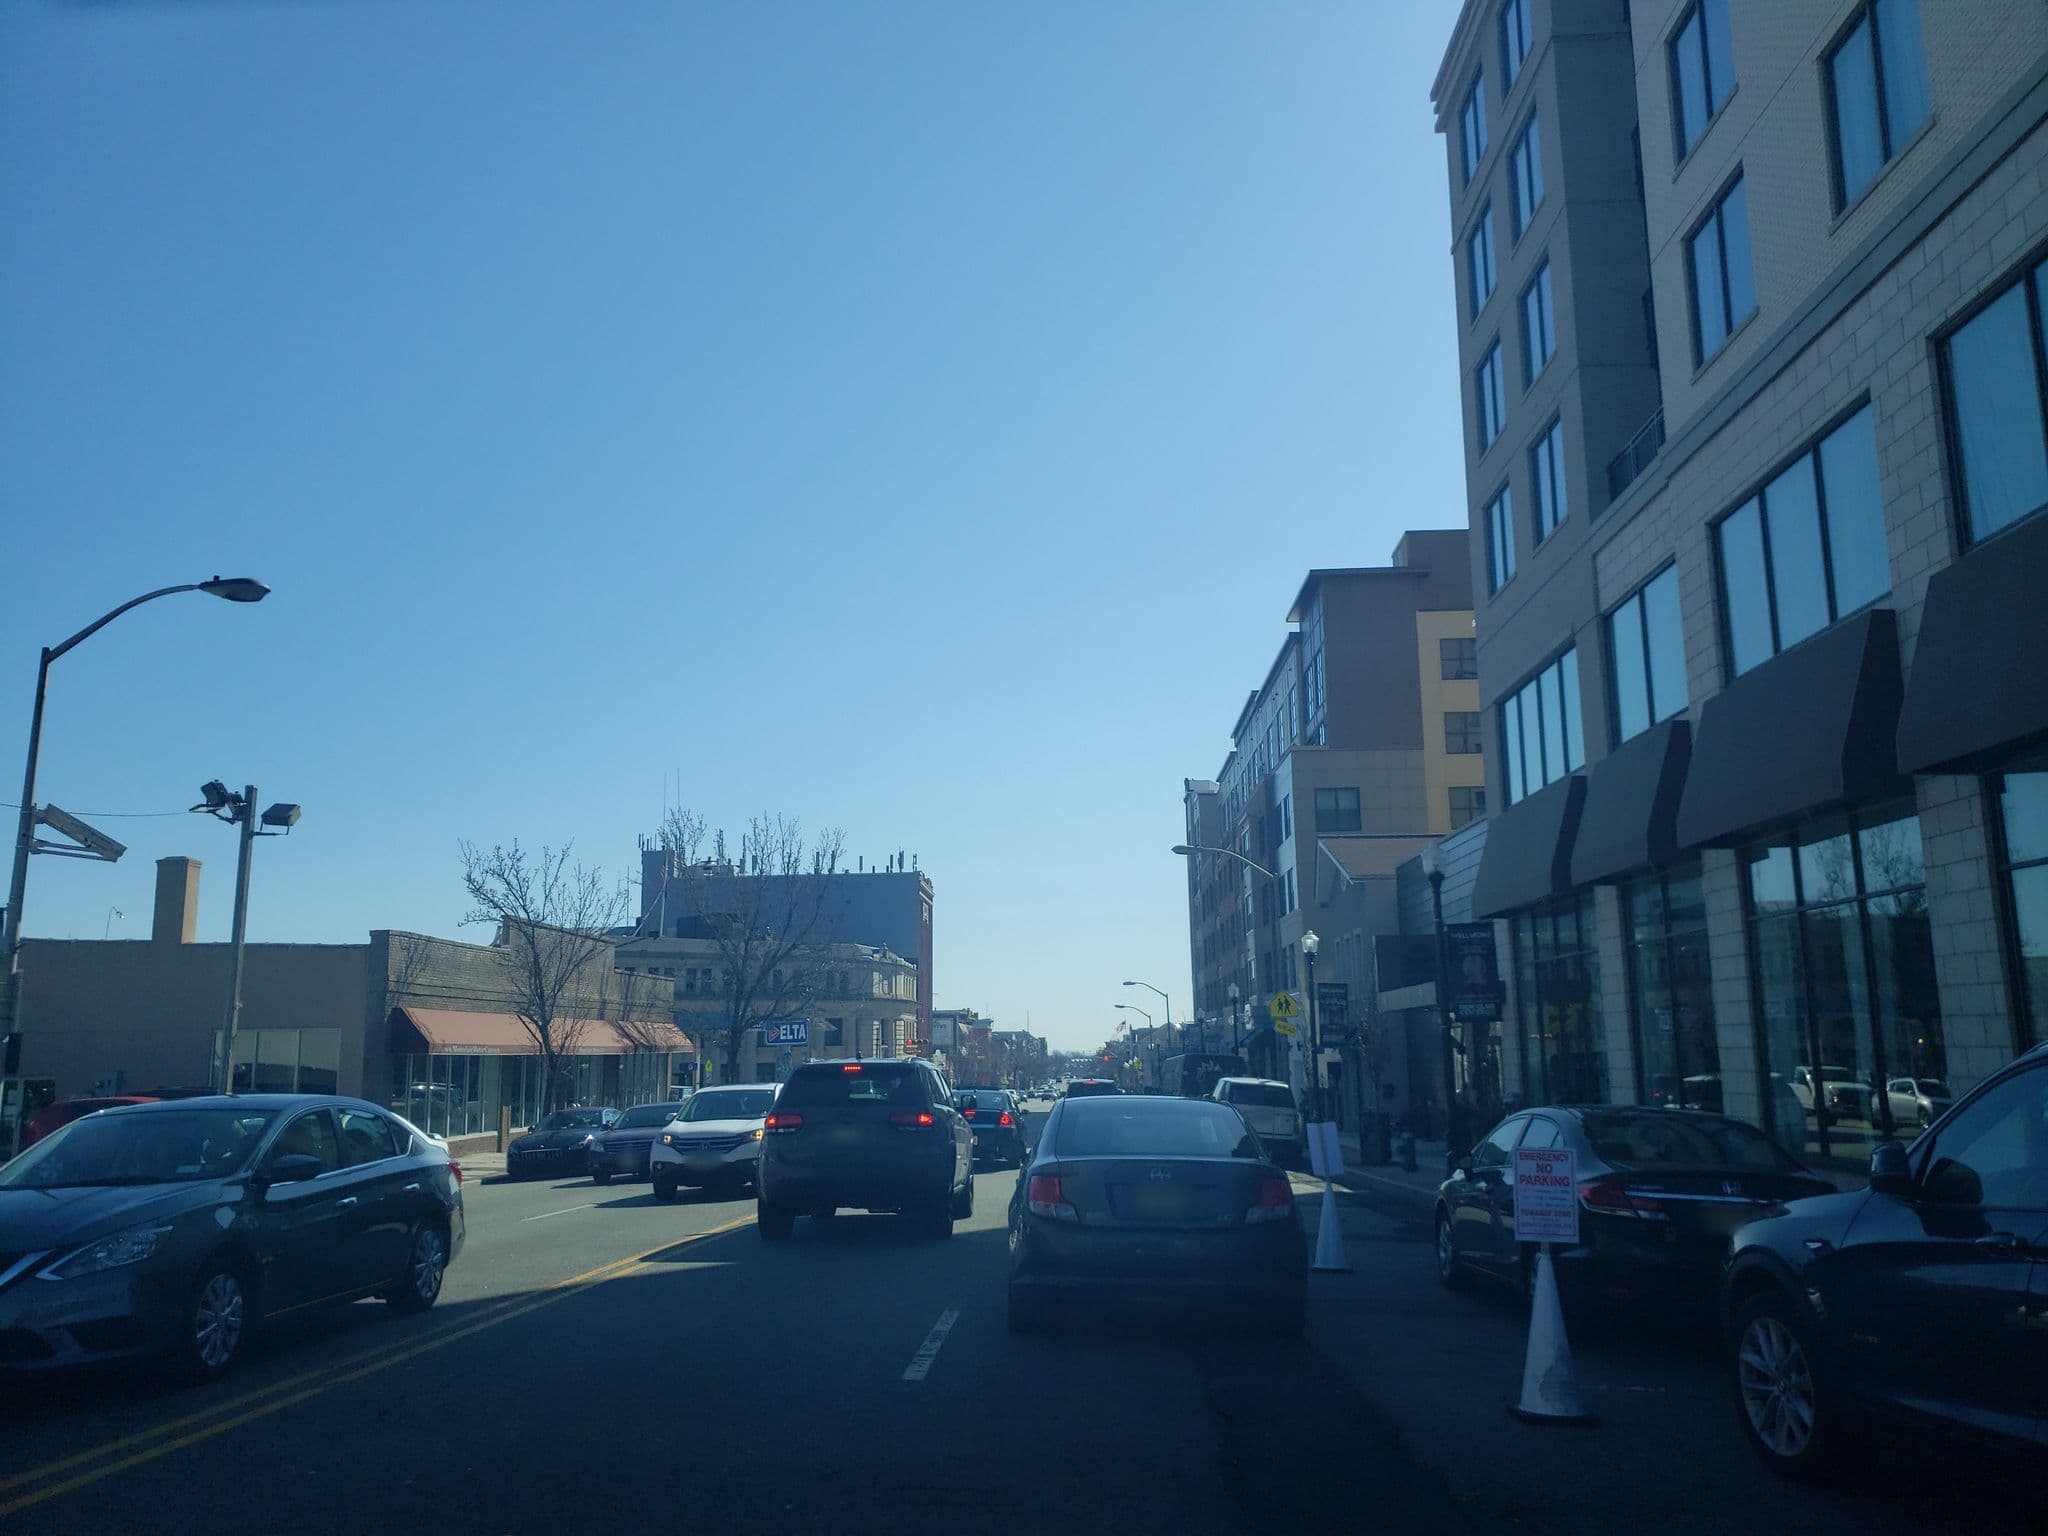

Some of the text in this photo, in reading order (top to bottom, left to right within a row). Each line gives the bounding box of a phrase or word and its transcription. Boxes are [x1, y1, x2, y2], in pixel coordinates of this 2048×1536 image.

[1519, 1152, 1569, 1162] EMERGENCY
[1536, 1163, 1553, 1174] NO
[1519, 1174, 1570, 1187] PARKING
